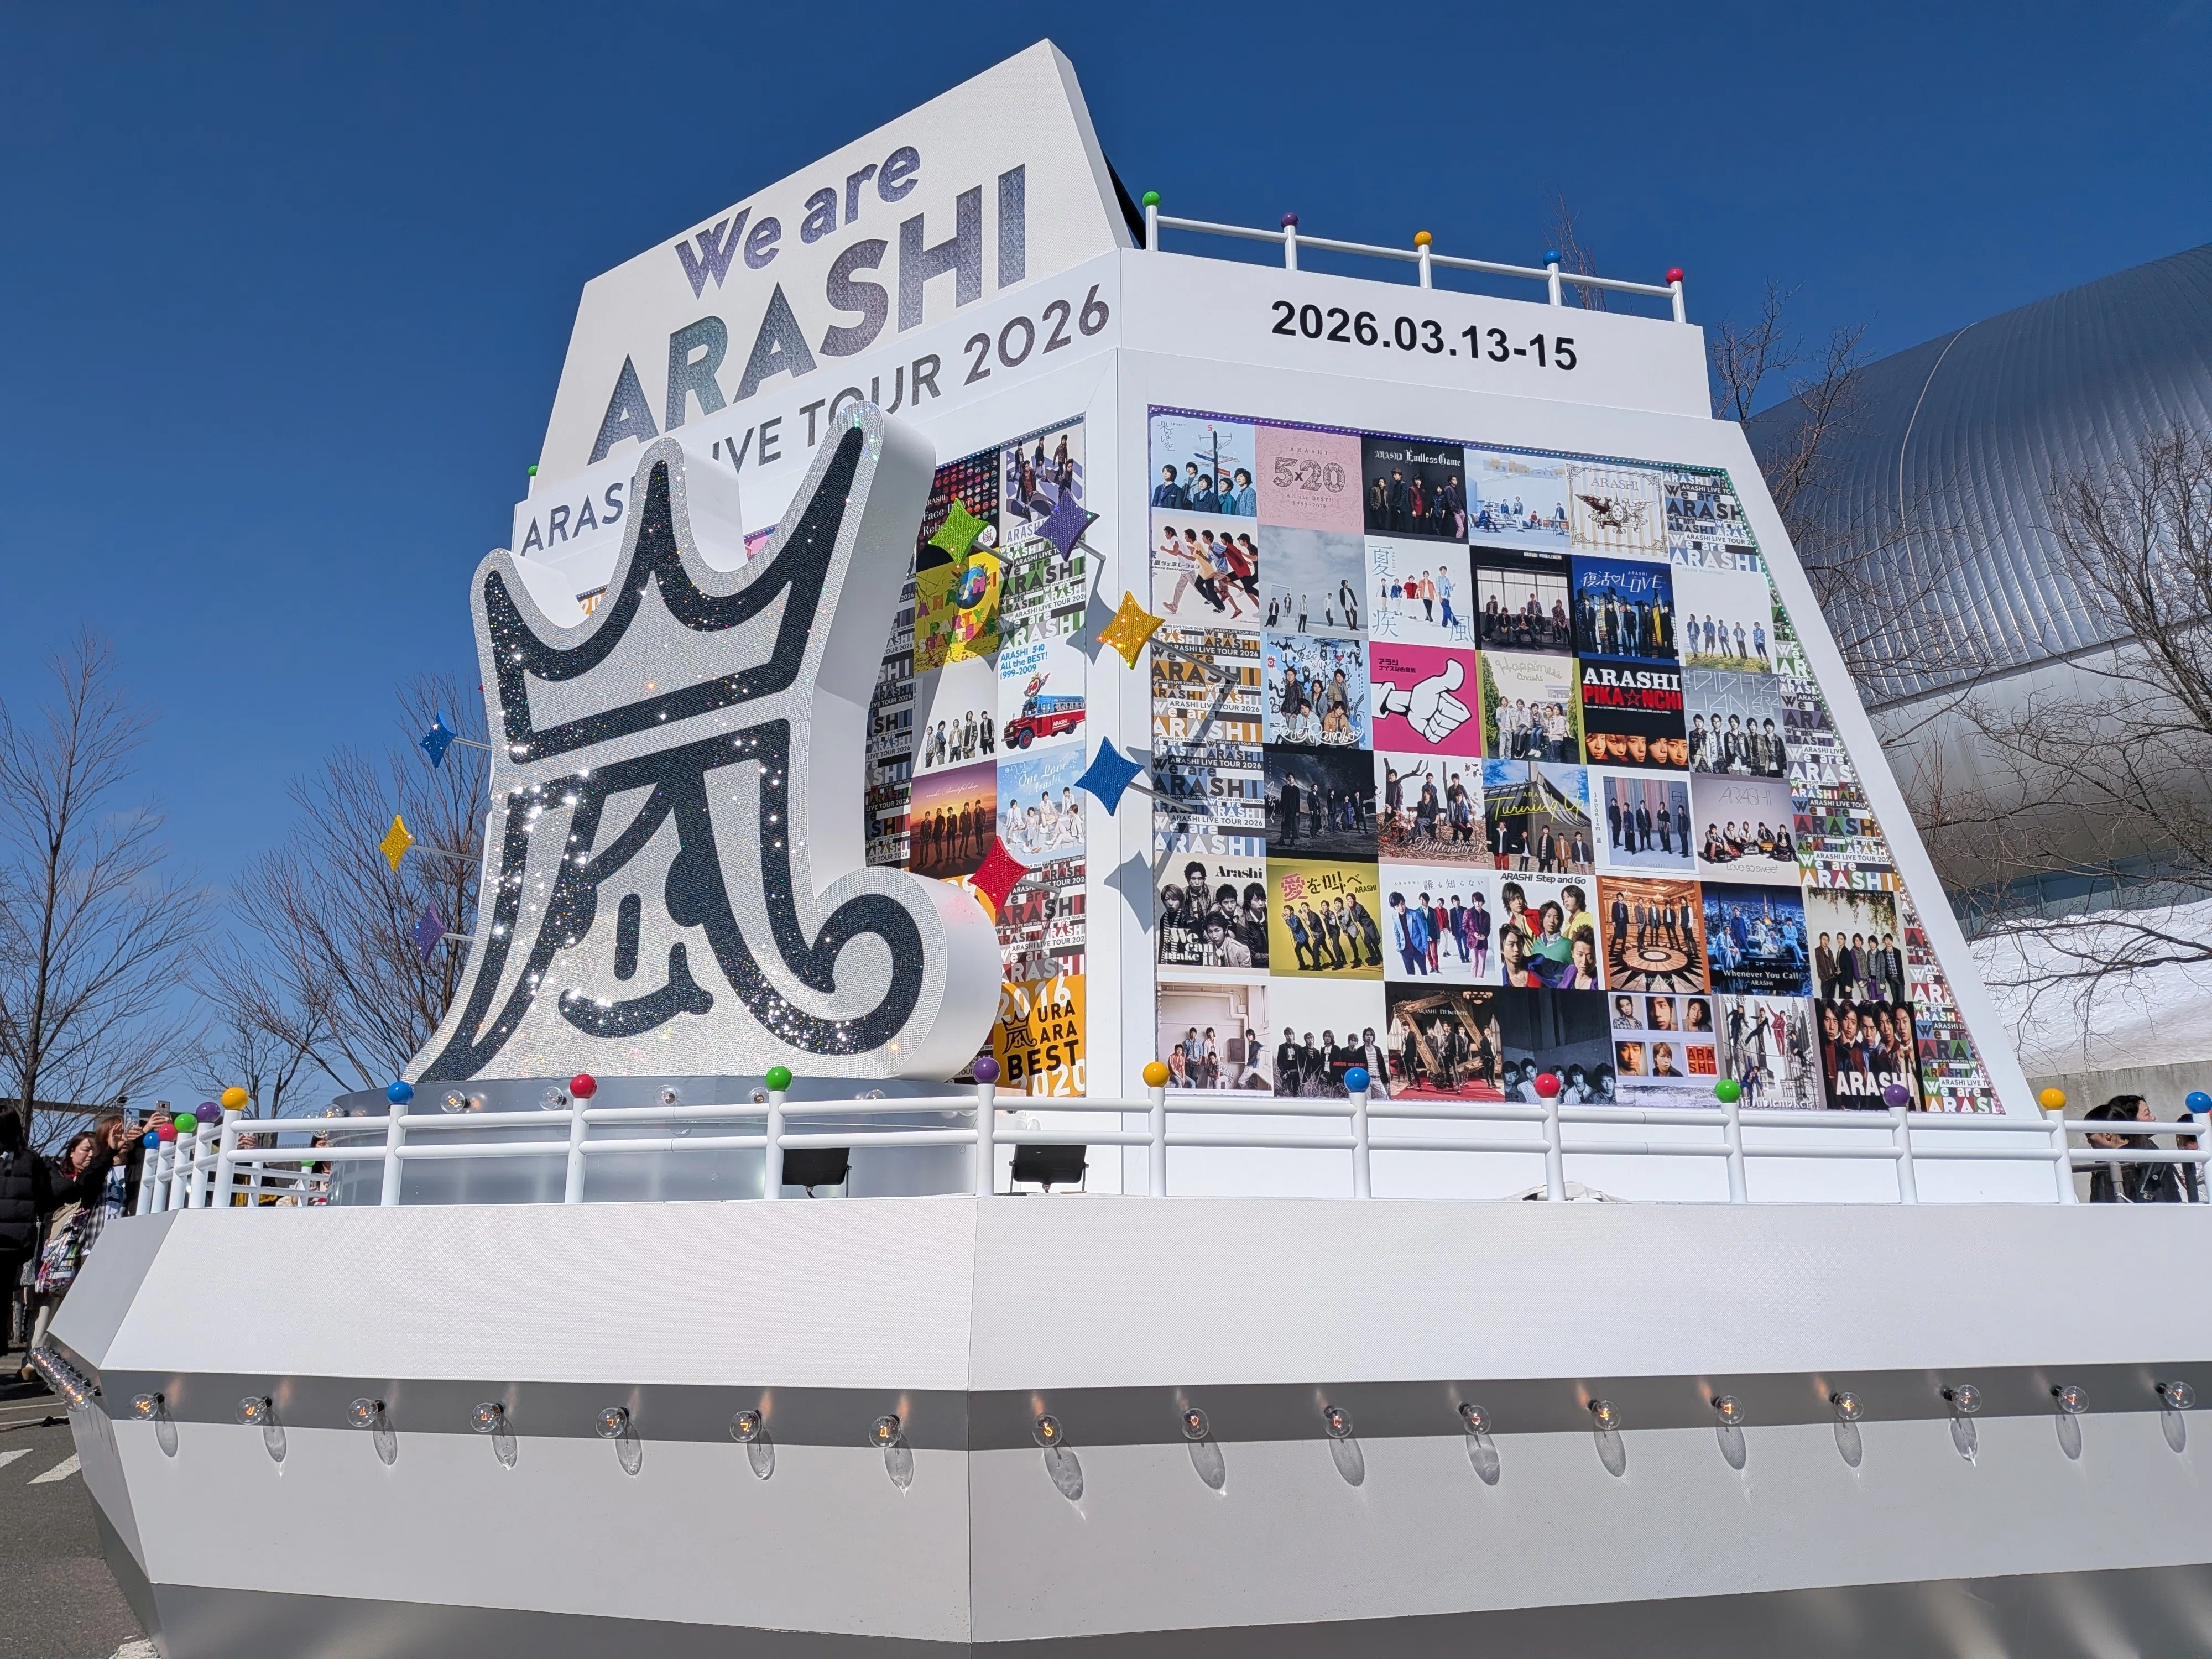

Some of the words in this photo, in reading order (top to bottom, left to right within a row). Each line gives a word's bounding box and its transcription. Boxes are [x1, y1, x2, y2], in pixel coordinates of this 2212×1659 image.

[674, 207, 781, 300] We
[800, 146, 920, 244] are
[587, 164, 1026, 465] ARASHI
[1271, 300, 1577, 371] 2026.03.13-15
[520, 479, 635, 557] ARAS
[962, 284, 1109, 386] 2026
[1157, 421, 1175, 452] 果てない空
[1290, 447, 1328, 456] ARASHI
[1375, 450, 1402, 461] ARASHI
[1404, 448, 1437, 465] Endless
[1438, 452, 1461, 468] Game
[1591, 478, 1639, 491] ARASHI
[1665, 485, 1689, 499] We
[1697, 492, 1721, 502] are
[924, 509, 944, 521] Face
[923, 523, 944, 536] Reb
[1007, 519, 1044, 542] ARASH
[1669, 534, 1693, 549] We
[1702, 542, 1725, 552] are
[1152, 560, 1200, 569] 風ジェネレーション
[1368, 545, 1395, 577] 夏
[930, 608, 984, 636] PARTY
[1372, 609, 1399, 637] 疾
[1449, 614, 1475, 644] 風
[1000, 648, 1029, 662] ARASHI
[1000, 661, 1011, 671] All
[1013, 658, 1025, 667] the
[1027, 651, 1048, 664] BEST!
[1000, 664, 1037, 680] 1999-2009
[1495, 656, 1562, 679] Happiness
[1517, 673, 1543, 681] Arashi
[1583, 667, 1681, 691] ARASHI
[1169, 700, 1198, 708] ARASHI
[1219, 703, 1239, 712] TOUR
[1241, 705, 1260, 713] 2026
[1154, 717, 1256, 743] ARASHI
[1022, 775, 1042, 789] One
[1045, 761, 1073, 782] Love
[1032, 773, 1067, 796] Arashi
[1154, 774, 1258, 797] ARASHI
[1718, 786, 1771, 806] ARASHI
[1484, 796, 1558, 823] Turning
[1564, 791, 1585, 822] Up
[1171, 815, 1201, 823] ARASHI
[1155, 832, 1260, 857] ARASHI
[1412, 836, 1483, 854] Bittersweet
[1215, 865, 1263, 879] Arashi
[1726, 863, 1745, 872] Love
[1756, 865, 1779, 873] sweet
[1281, 871, 1362, 902] 愛を叫べ
[1354, 884, 1378, 894] ARASHI
[1422, 879, 1484, 890] 誰も知らない
[1500, 873, 1533, 882] ARASHI
[1536, 874, 1556, 884] Step
[1557, 875, 1572, 884] and
[1574, 877, 1587, 885] Go
[1801, 869, 1894, 891] ARASHI
[997, 895, 1085, 927] ARASHI
[1169, 927, 1199, 943] We
[1163, 951, 1200, 961] make
[1185, 943, 1213, 952] can
[1723, 969, 1762, 978] Whenever
[1037, 999, 1076, 1023] URA
[1040, 1020, 1078, 1045] ARA
[1007, 1039, 1079, 1081] BEST
[1688, 1048, 1715, 1061] ARA
[1689, 1061, 1713, 1073] SHI
[1836, 1071, 1914, 1097] ARASHI
